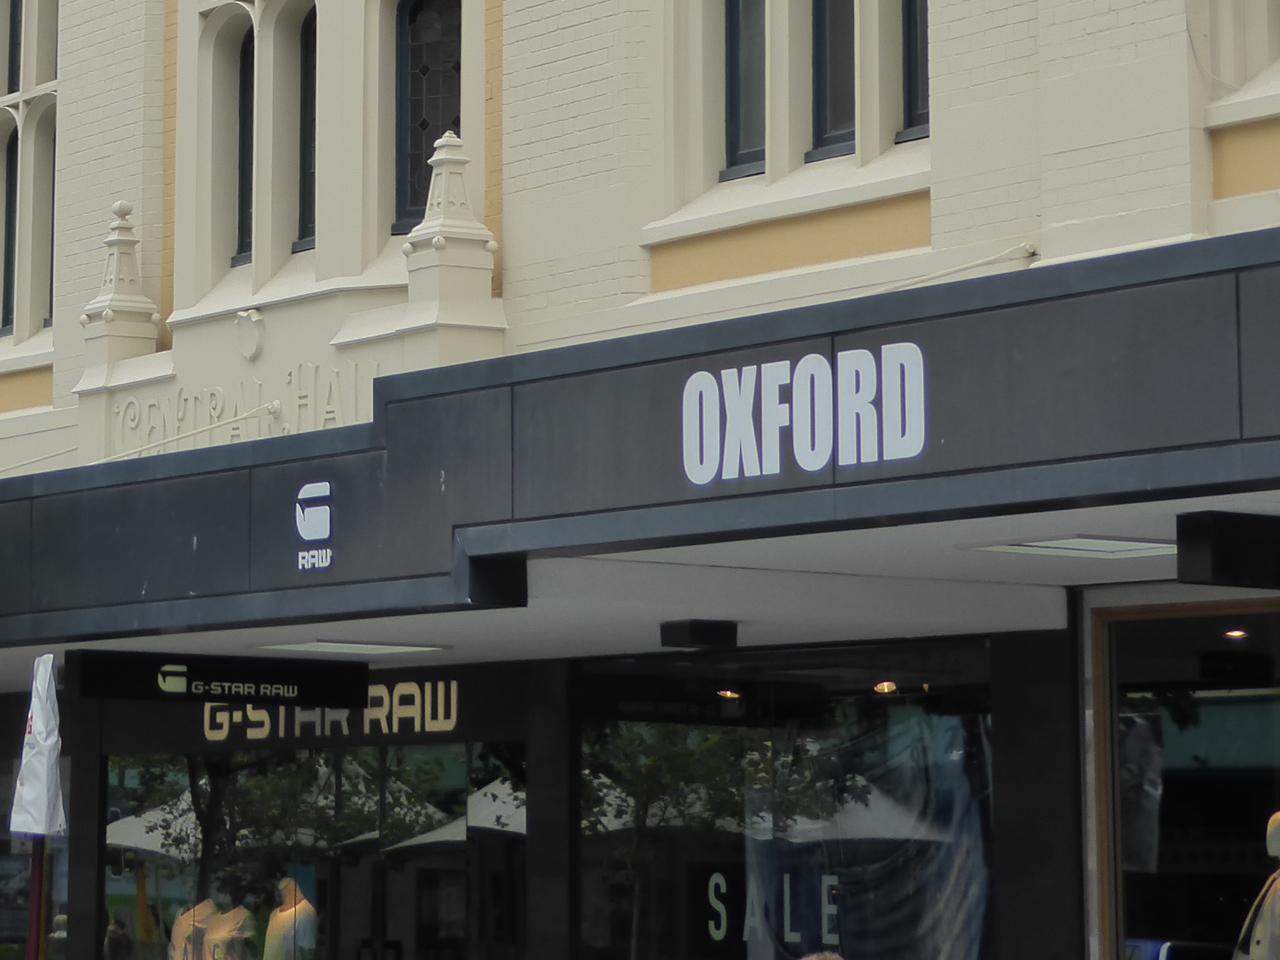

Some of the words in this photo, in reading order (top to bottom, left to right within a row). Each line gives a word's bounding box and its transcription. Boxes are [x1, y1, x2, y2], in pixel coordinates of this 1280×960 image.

[286, 358, 379, 438] HAL
[682, 342, 925, 485] OXFORD
[298, 549, 332, 570] RAW
[192, 680, 257, 696] G-STAR
[260, 683, 298, 697] RAW
[363, 679, 458, 735] RAW
[706, 871, 841, 945] SALE
